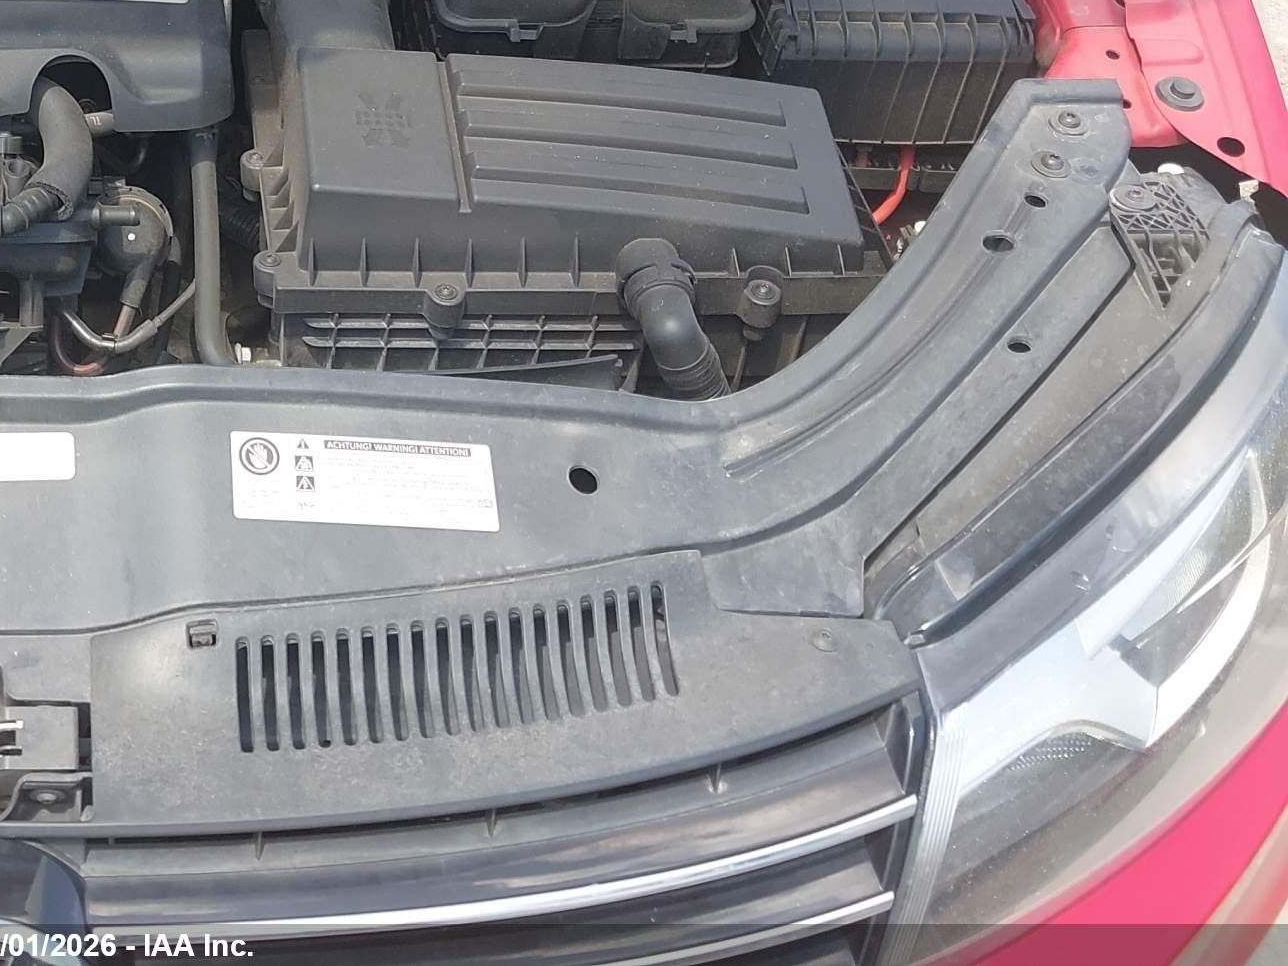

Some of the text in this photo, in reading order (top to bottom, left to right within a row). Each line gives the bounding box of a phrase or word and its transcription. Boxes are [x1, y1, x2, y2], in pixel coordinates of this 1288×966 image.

[327, 441, 469, 457] ACHTUNG! WARNING! ATTENTION!
